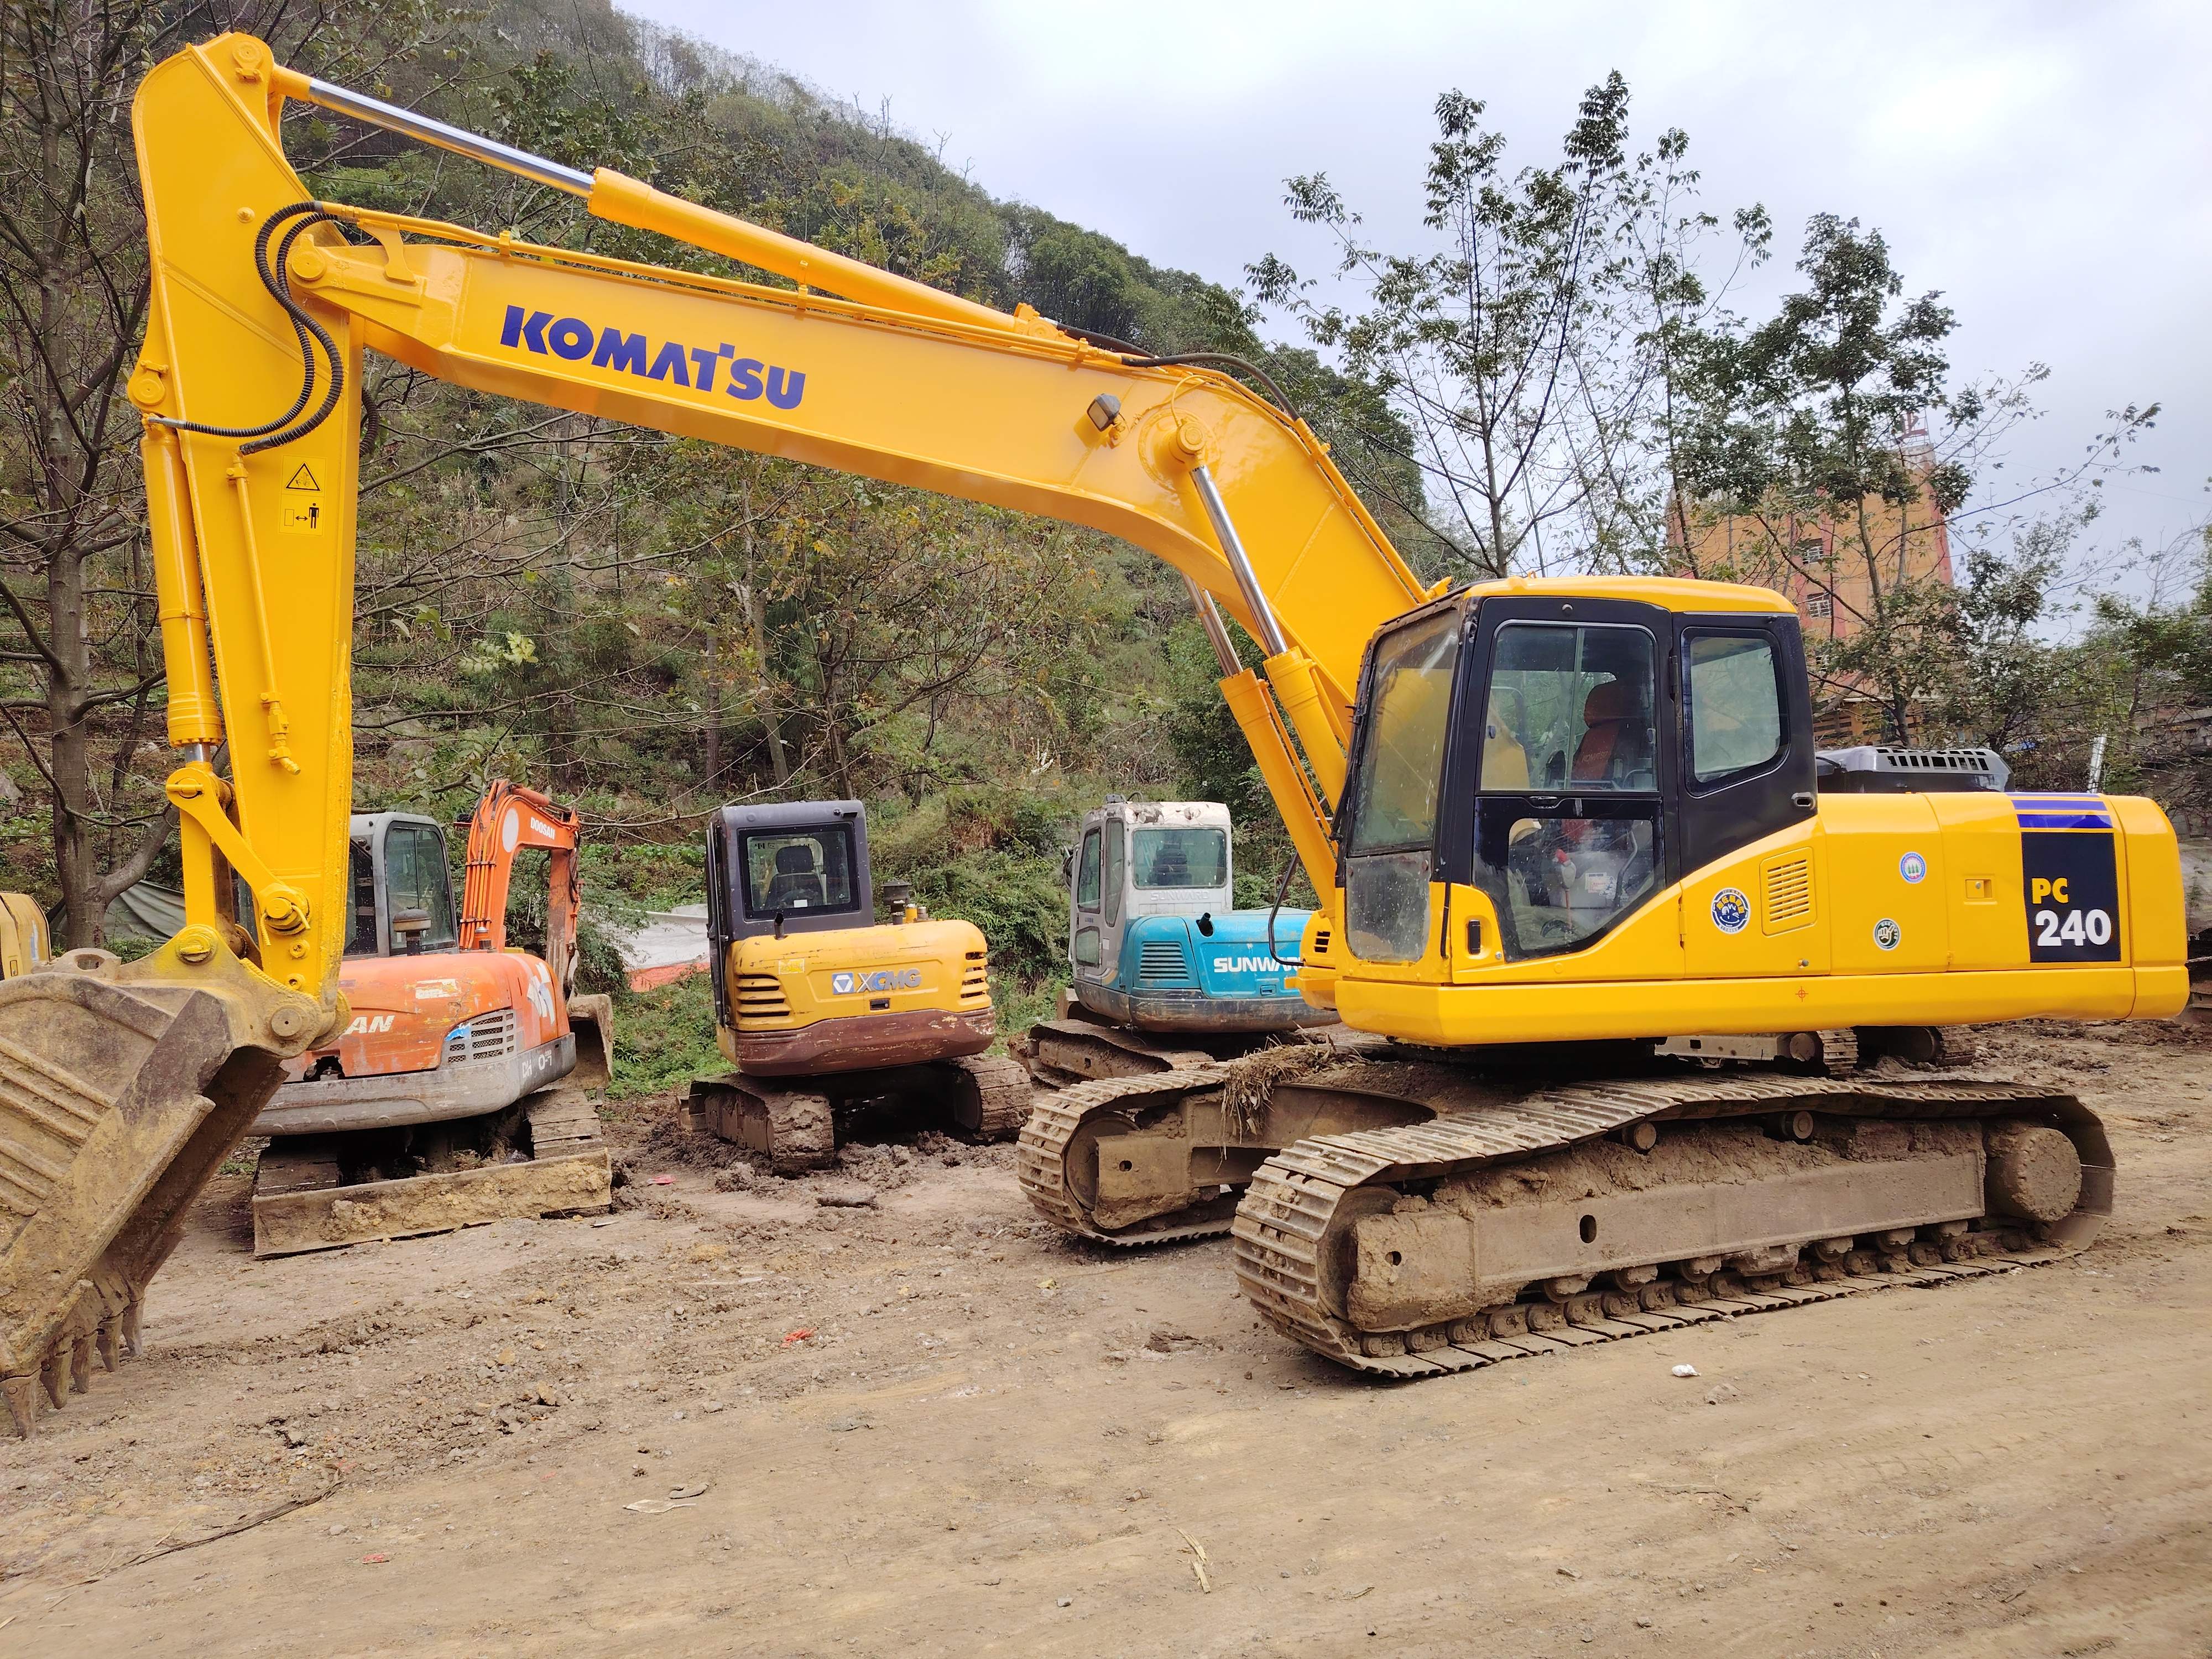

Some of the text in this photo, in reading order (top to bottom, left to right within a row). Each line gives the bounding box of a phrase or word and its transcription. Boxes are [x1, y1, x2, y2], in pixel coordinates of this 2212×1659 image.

[500, 304, 806, 409] KOMATSU
[530, 817, 555, 841] DOOSAN
[1150, 890, 1210, 901] SUNWARD
[2031, 878, 2069, 904] PC
[2035, 909, 2112, 946] 240
[1213, 956, 1301, 973] SUNWAR
[857, 968, 922, 993] XCMG
